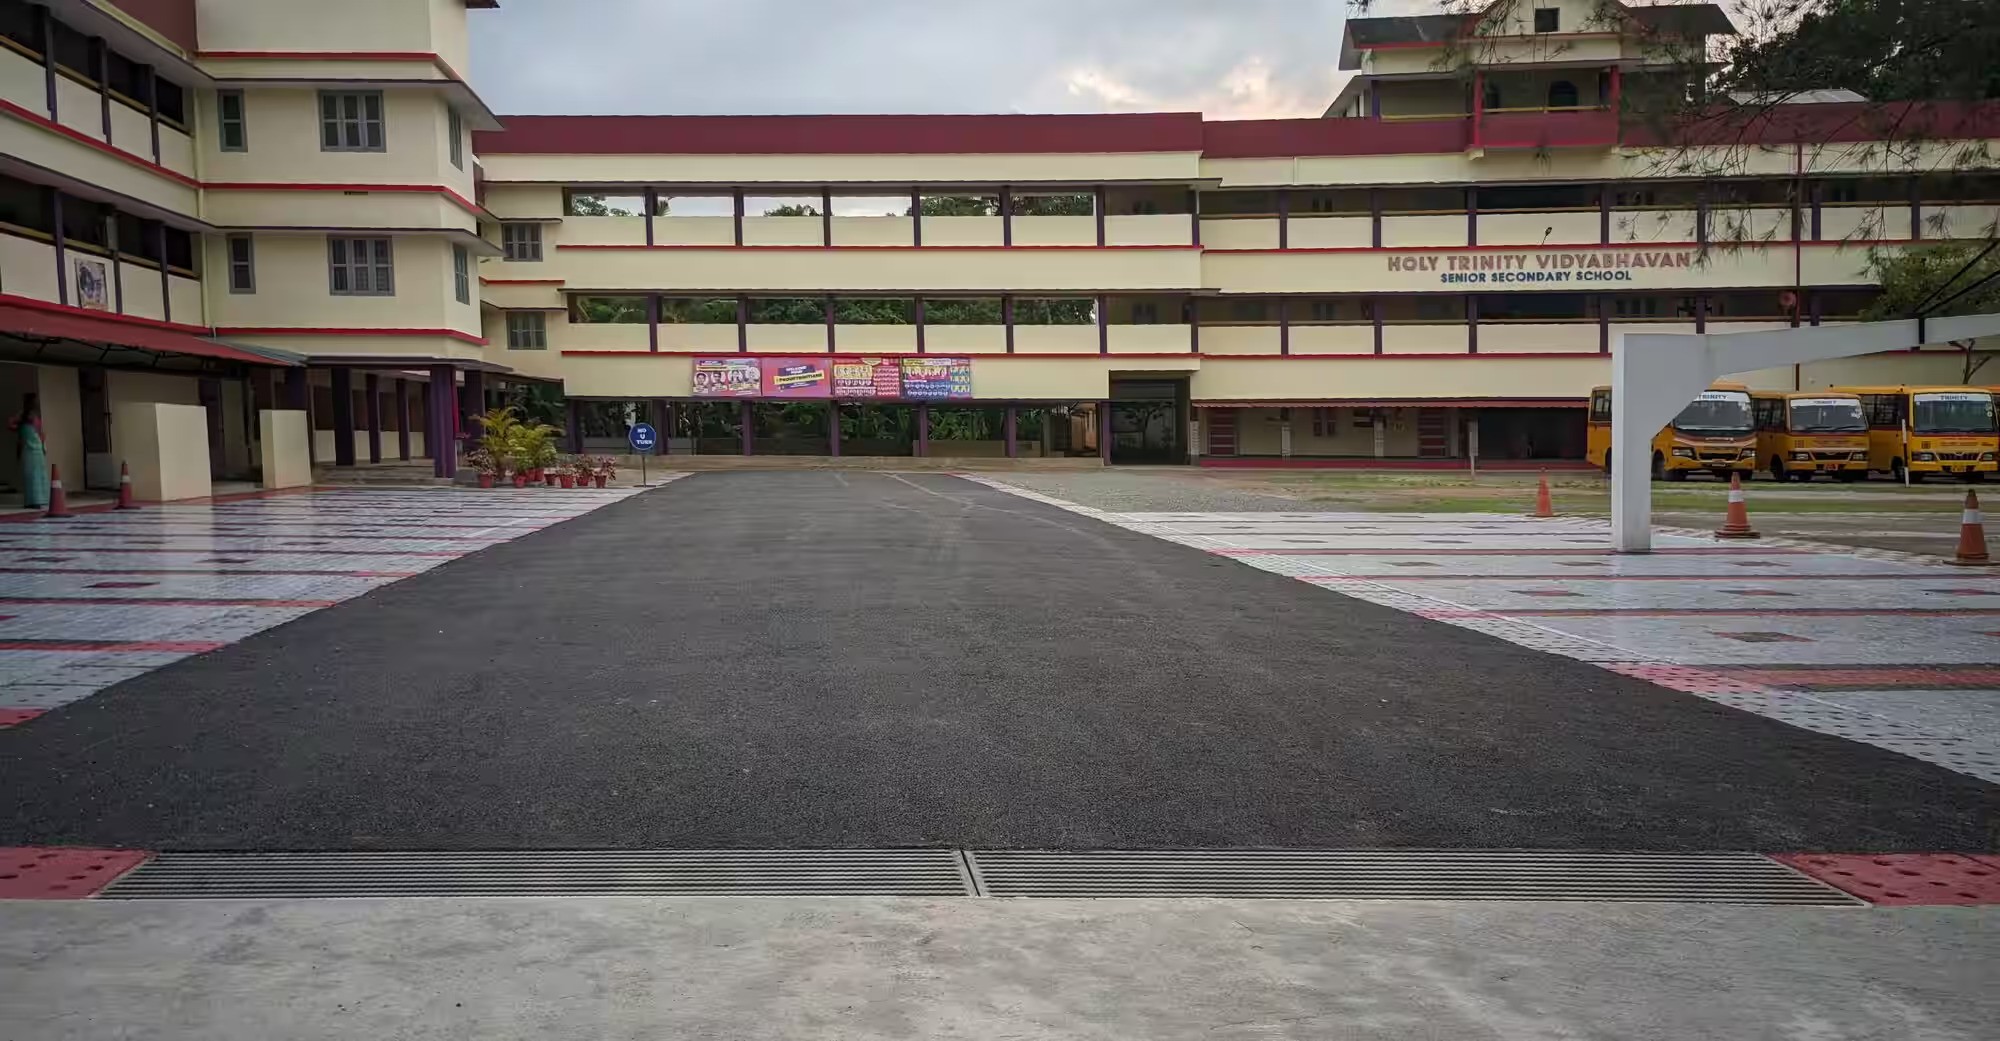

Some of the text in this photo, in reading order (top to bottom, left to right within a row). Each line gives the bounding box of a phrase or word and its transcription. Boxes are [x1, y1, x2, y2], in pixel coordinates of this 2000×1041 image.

[1388, 252, 1691, 272] HOLY TRINITY VIDYABHAVAN
[1441, 270, 1632, 283] SENIOR SECONDARY SCHOOL
